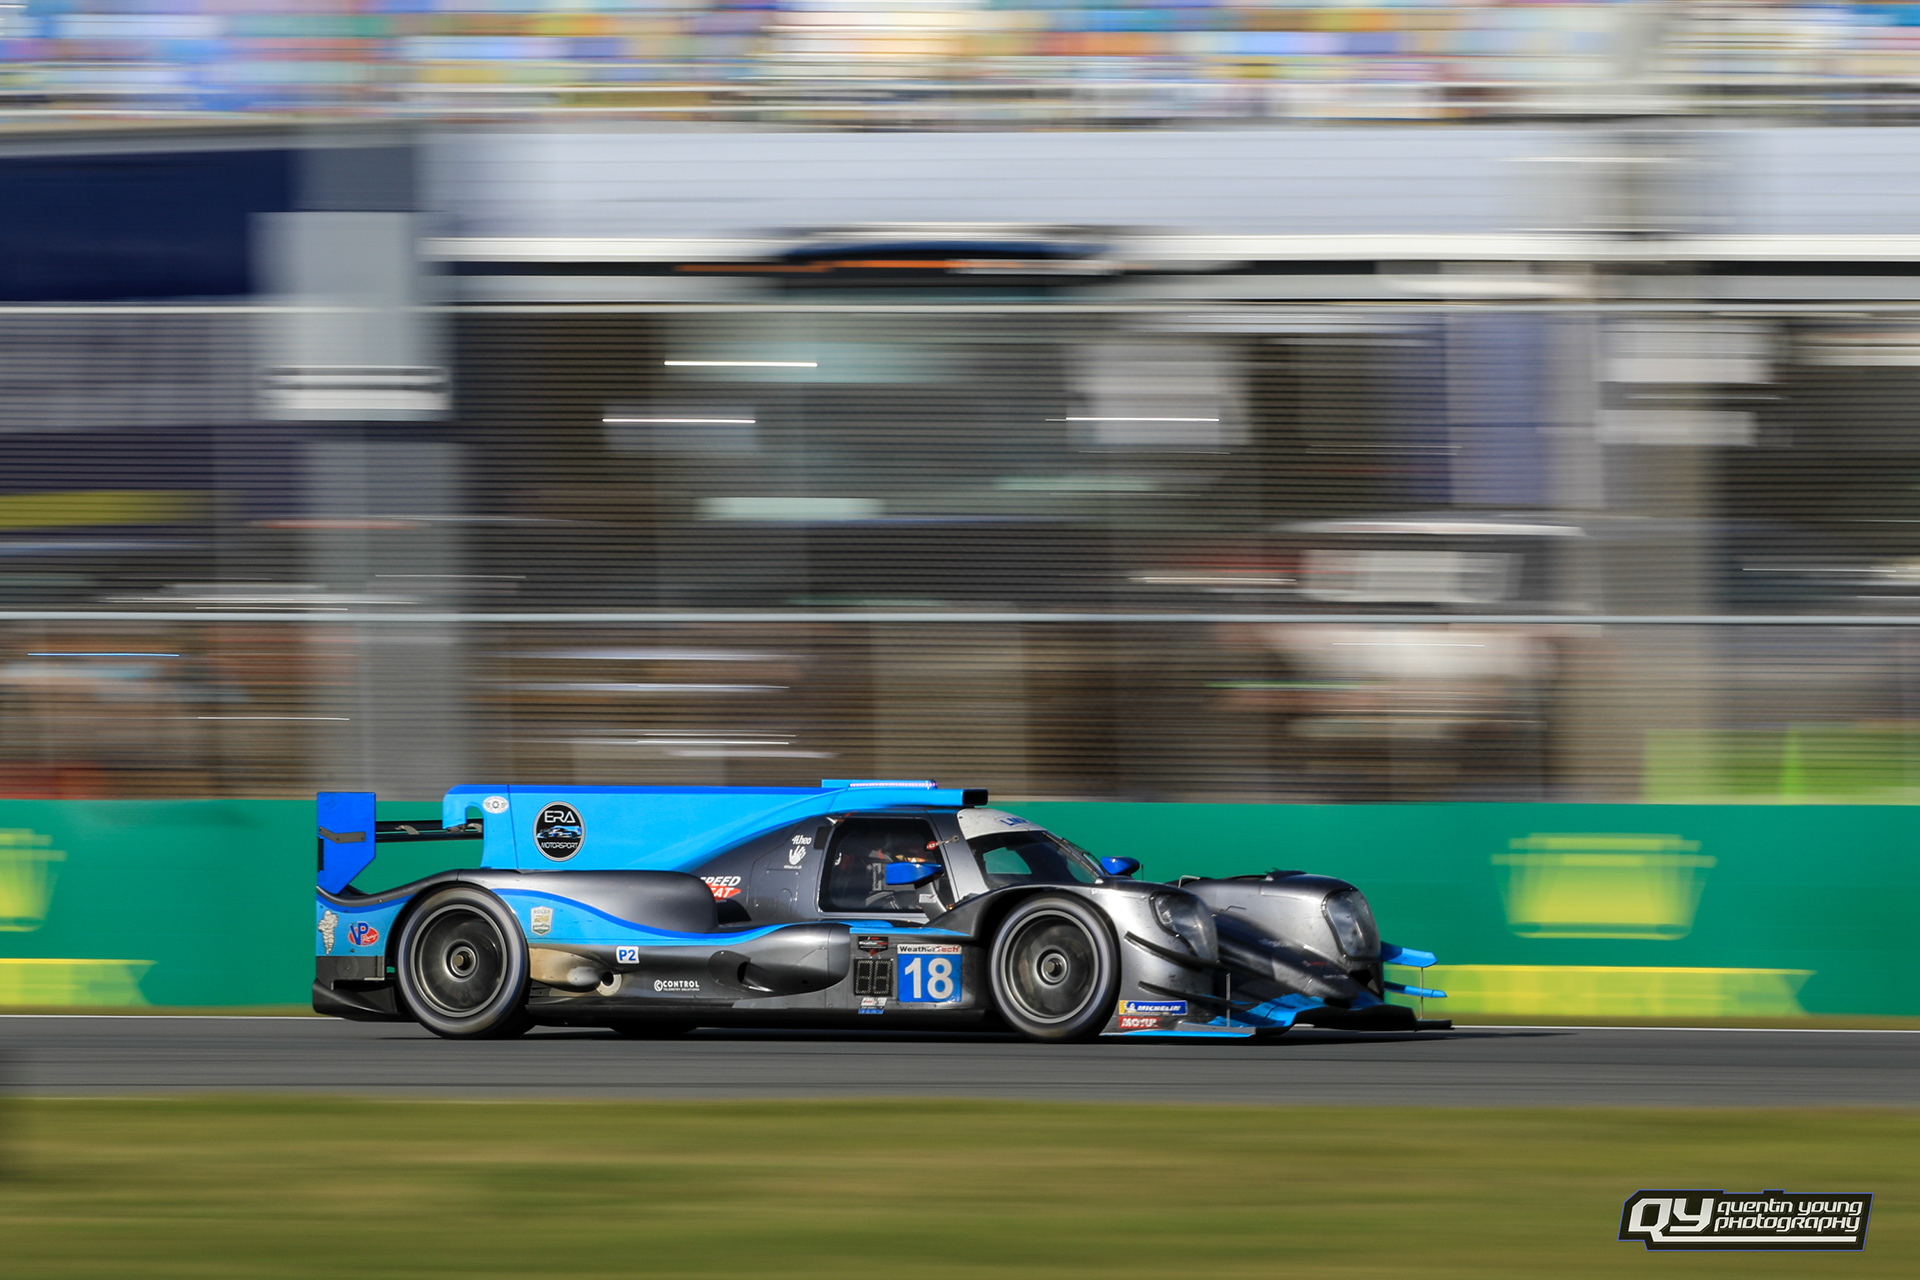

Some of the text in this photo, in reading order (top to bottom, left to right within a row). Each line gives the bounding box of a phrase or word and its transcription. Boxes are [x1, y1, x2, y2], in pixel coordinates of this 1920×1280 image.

[544, 811, 576, 823] ERA
[349, 921, 369, 946] VP
[618, 950, 638, 961] P2
[663, 980, 700, 988] CONTROL
[904, 957, 954, 1000] 18
